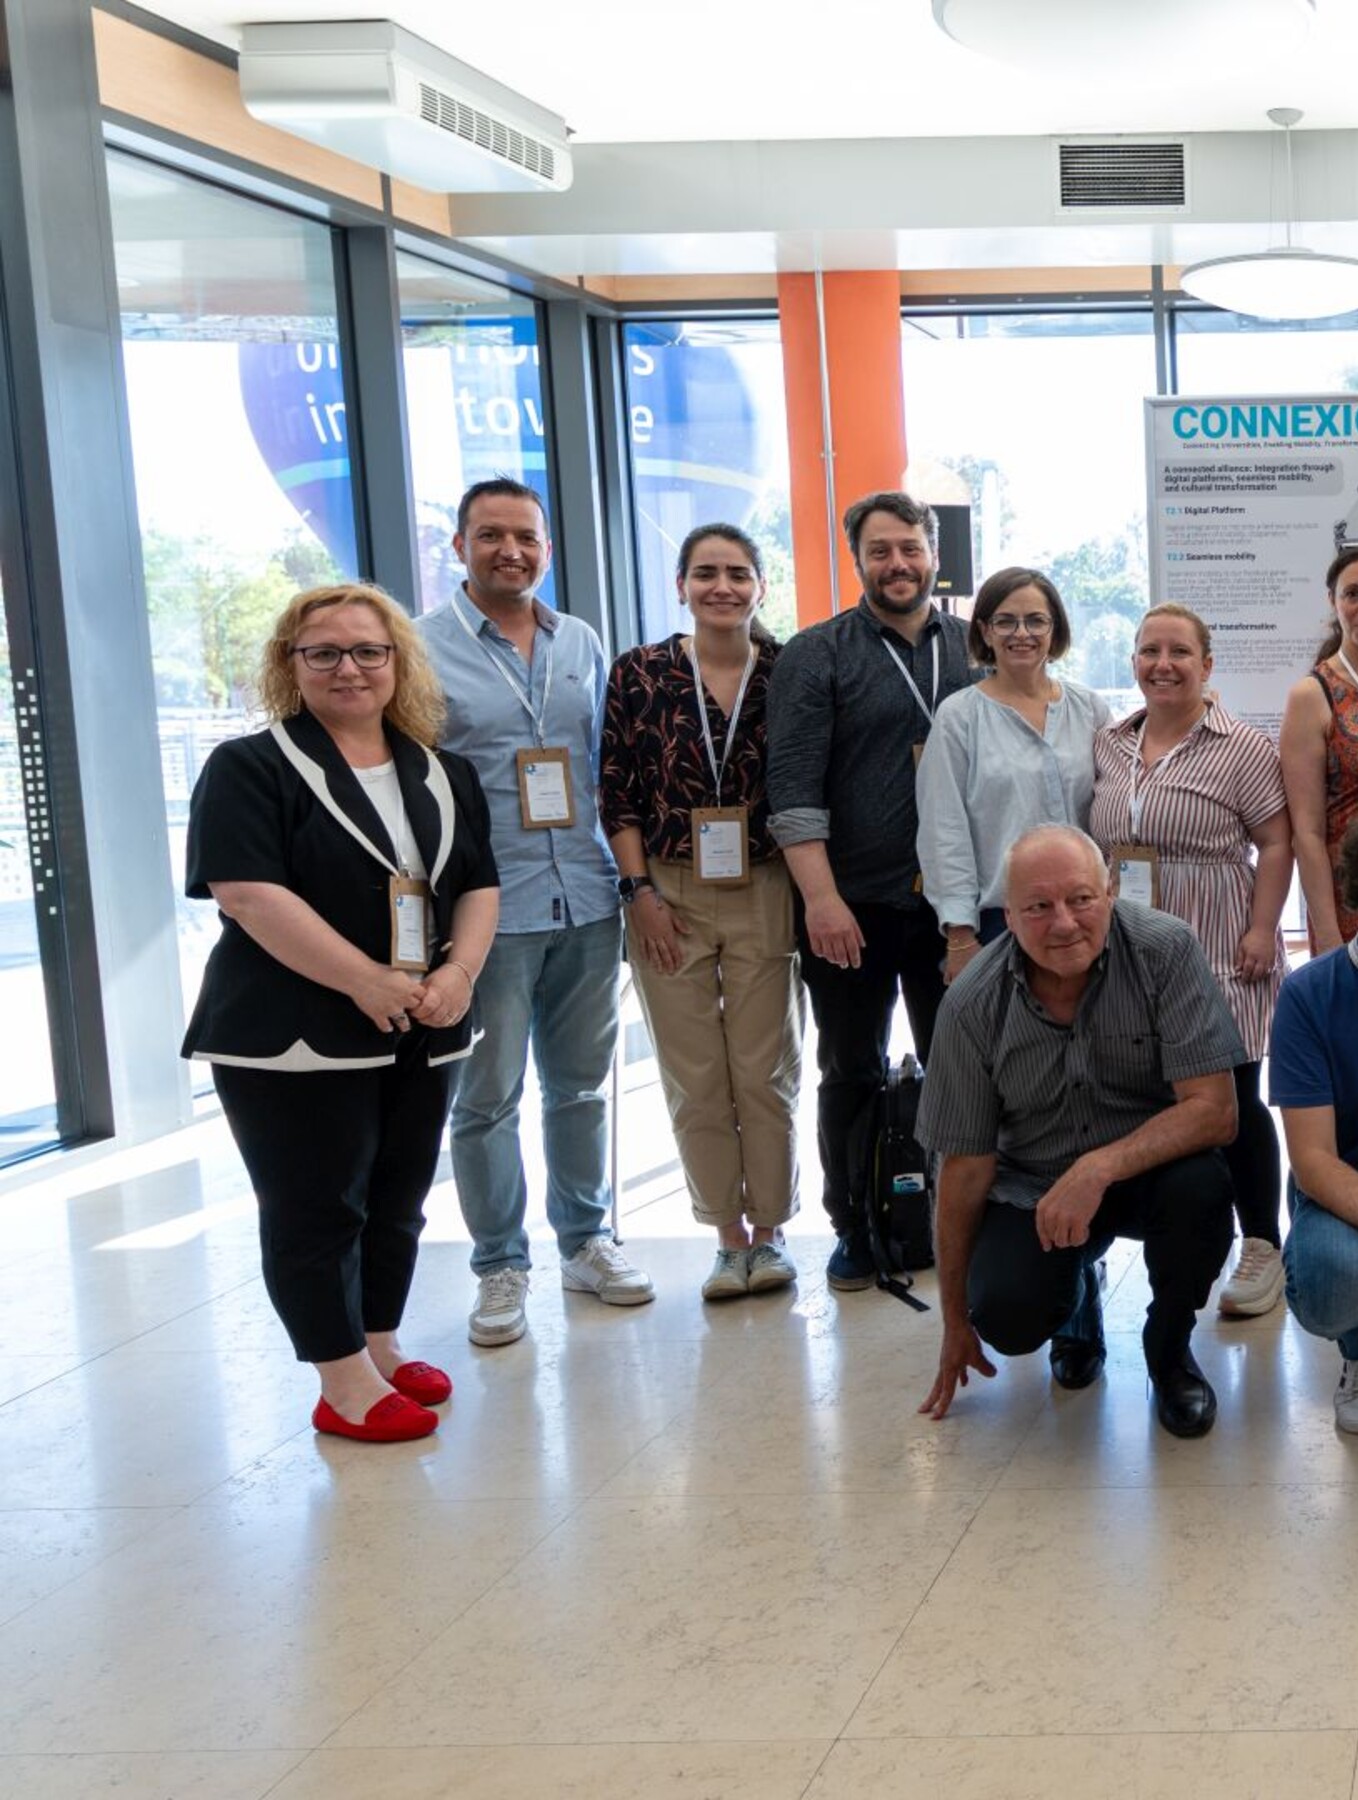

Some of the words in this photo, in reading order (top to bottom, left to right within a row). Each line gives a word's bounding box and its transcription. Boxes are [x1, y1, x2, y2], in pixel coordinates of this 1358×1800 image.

[1172, 465, 1216, 474] connected
[1217, 464, 1252, 473] alliance:
[1302, 463, 1335, 473] through
[1164, 474, 1190, 483] digital
[1236, 473, 1276, 482] seamless
[1164, 484, 1179, 492] and
[1181, 483, 1213, 492] cultural
[1214, 483, 1278, 492] transformation
[1184, 506, 1210, 516] Digital
[1211, 506, 1246, 515] Platform
[1186, 553, 1222, 561] Seamless
[1224, 552, 1256, 562] mobility
[1219, 623, 1278, 632] transformation
